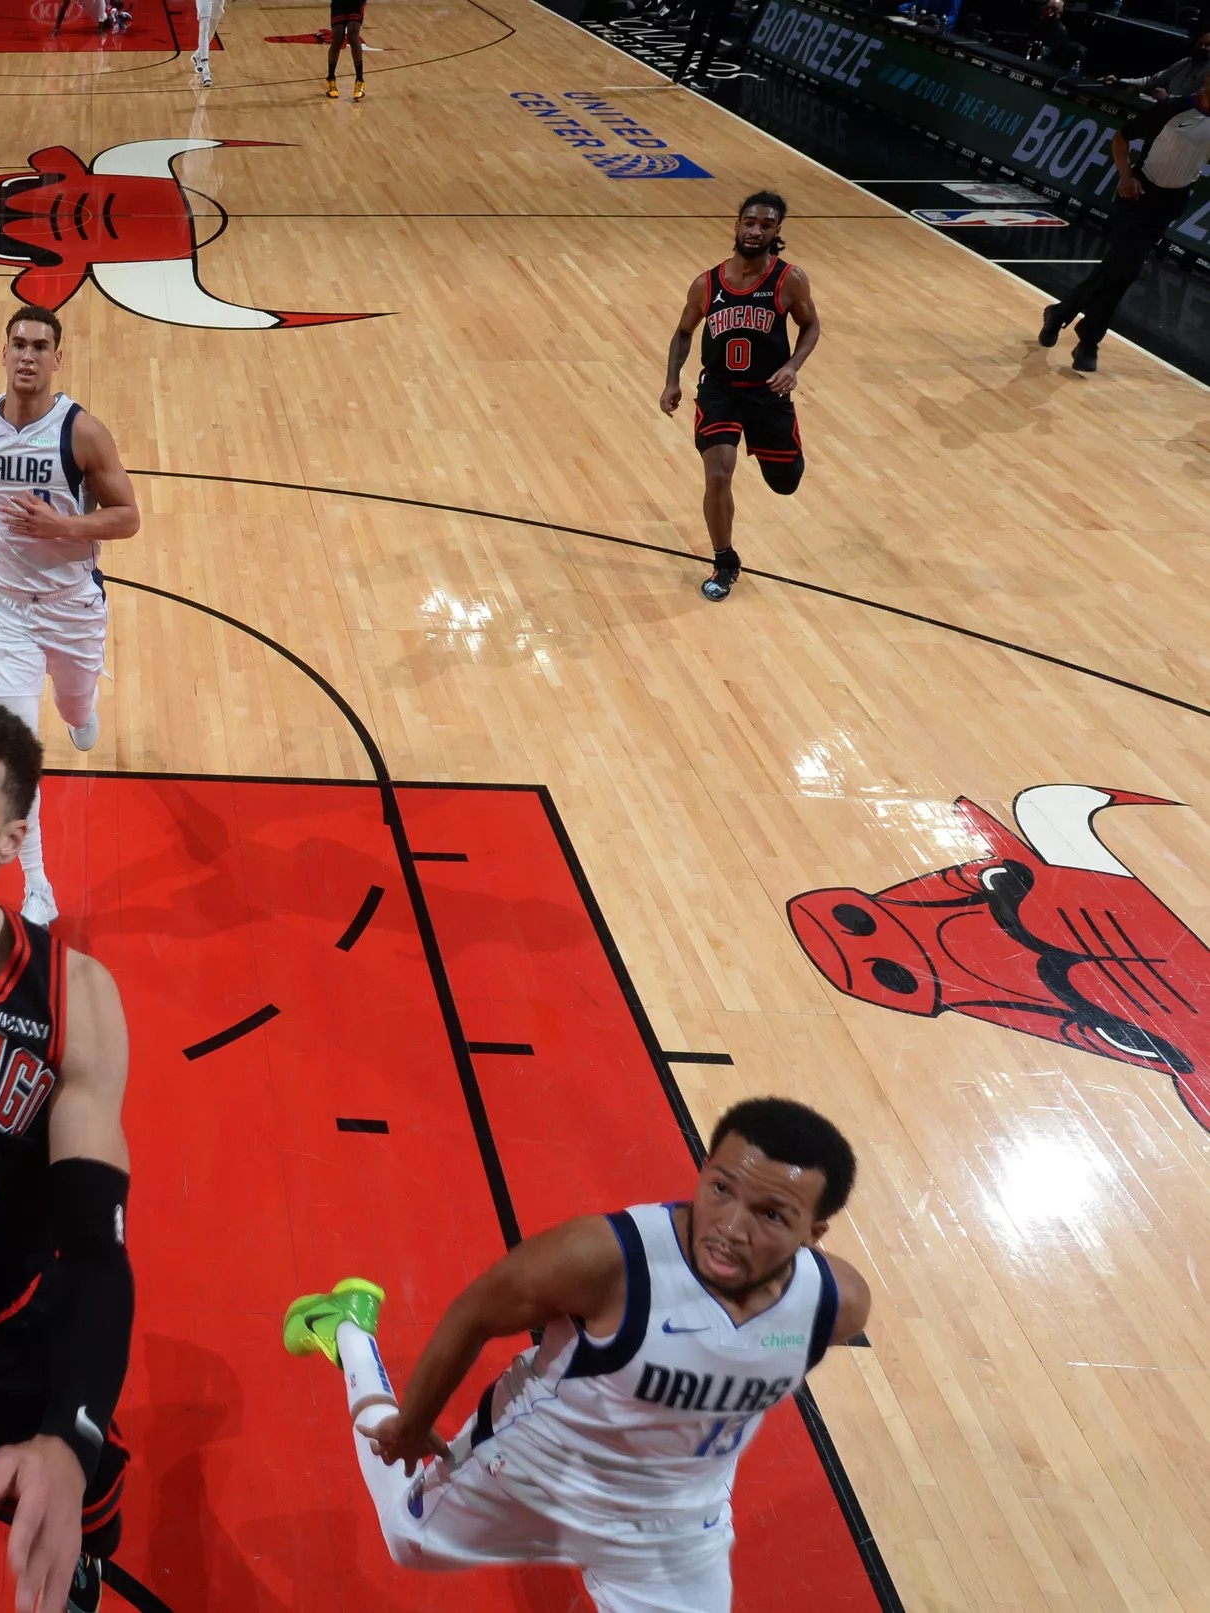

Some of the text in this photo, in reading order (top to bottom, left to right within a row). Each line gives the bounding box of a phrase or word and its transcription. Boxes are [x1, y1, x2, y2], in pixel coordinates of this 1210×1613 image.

[510, 92, 606, 148] CENTER
[563, 92, 667, 149] UNITED
[914, 77, 1024, 136] COOL THE PAIN
[707, 306, 775, 339] CHICAGO
[726, 338, 751, 371] 0
[760, 1331, 806, 1348] chime
[634, 1361, 794, 1412] DALLAS
